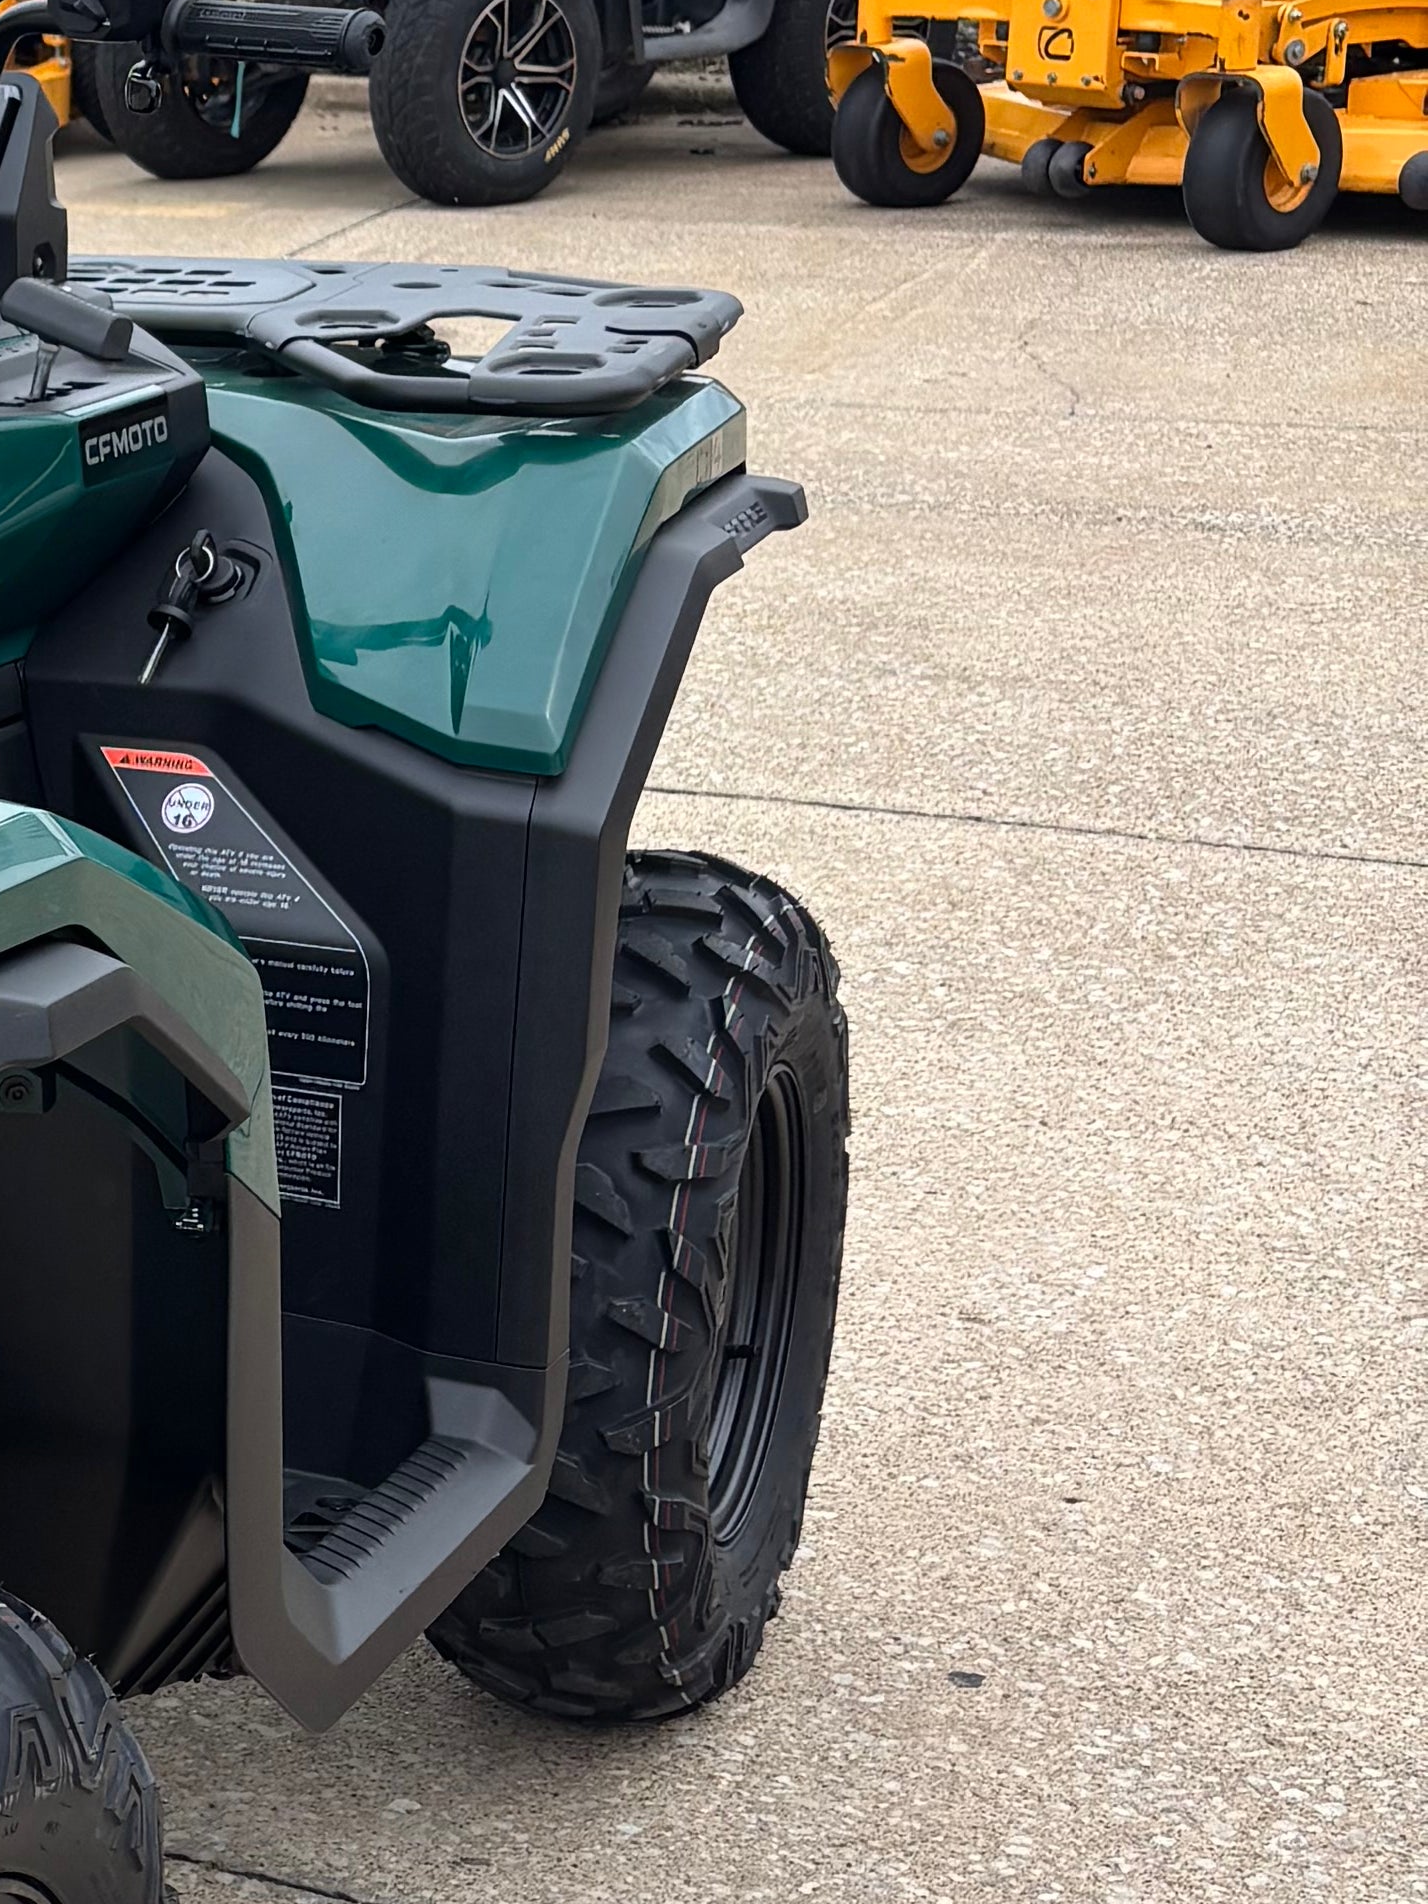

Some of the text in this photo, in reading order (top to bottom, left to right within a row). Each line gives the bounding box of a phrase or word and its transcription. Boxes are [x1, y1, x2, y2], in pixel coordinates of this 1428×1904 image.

[85, 415, 168, 466] CFMOTO
[134, 756, 193, 770] WARNING
[168, 799, 209, 811] UNDER
[173, 814, 193, 828] 16
